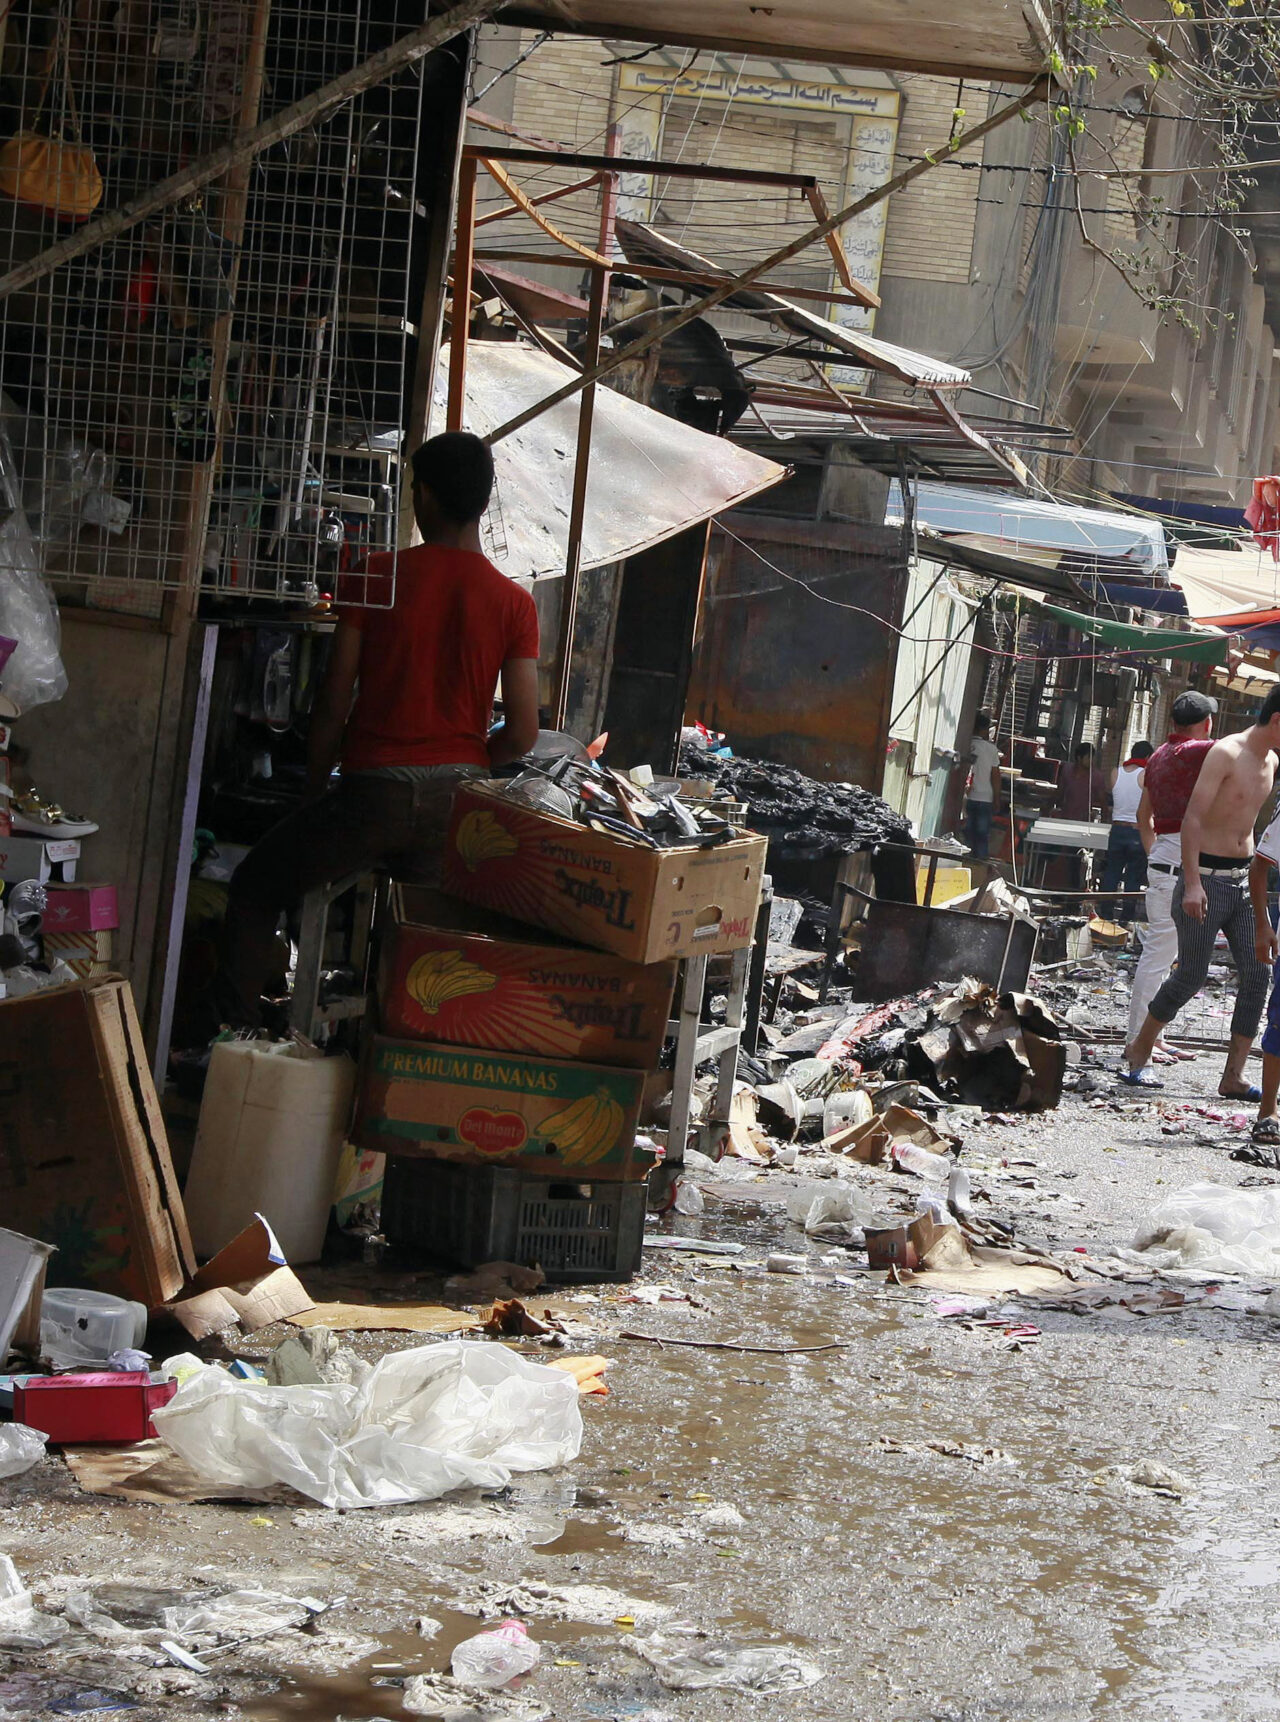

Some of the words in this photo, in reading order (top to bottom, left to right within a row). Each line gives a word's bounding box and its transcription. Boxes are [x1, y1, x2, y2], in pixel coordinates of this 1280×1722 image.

[636, 71, 728, 93] الرحيم
[728, 80, 798, 101] الرحمن
[798, 83, 831, 102] الله
[831, 88, 878, 112] بسم
[540, 838, 613, 875] BANANAS
[528, 968, 622, 992] BANANAS
[382, 1052, 469, 1081] PREMIUM
[473, 1062, 558, 1091] BANANAS
[462, 1117, 482, 1134] Del
[484, 1119, 524, 1139] Monte
